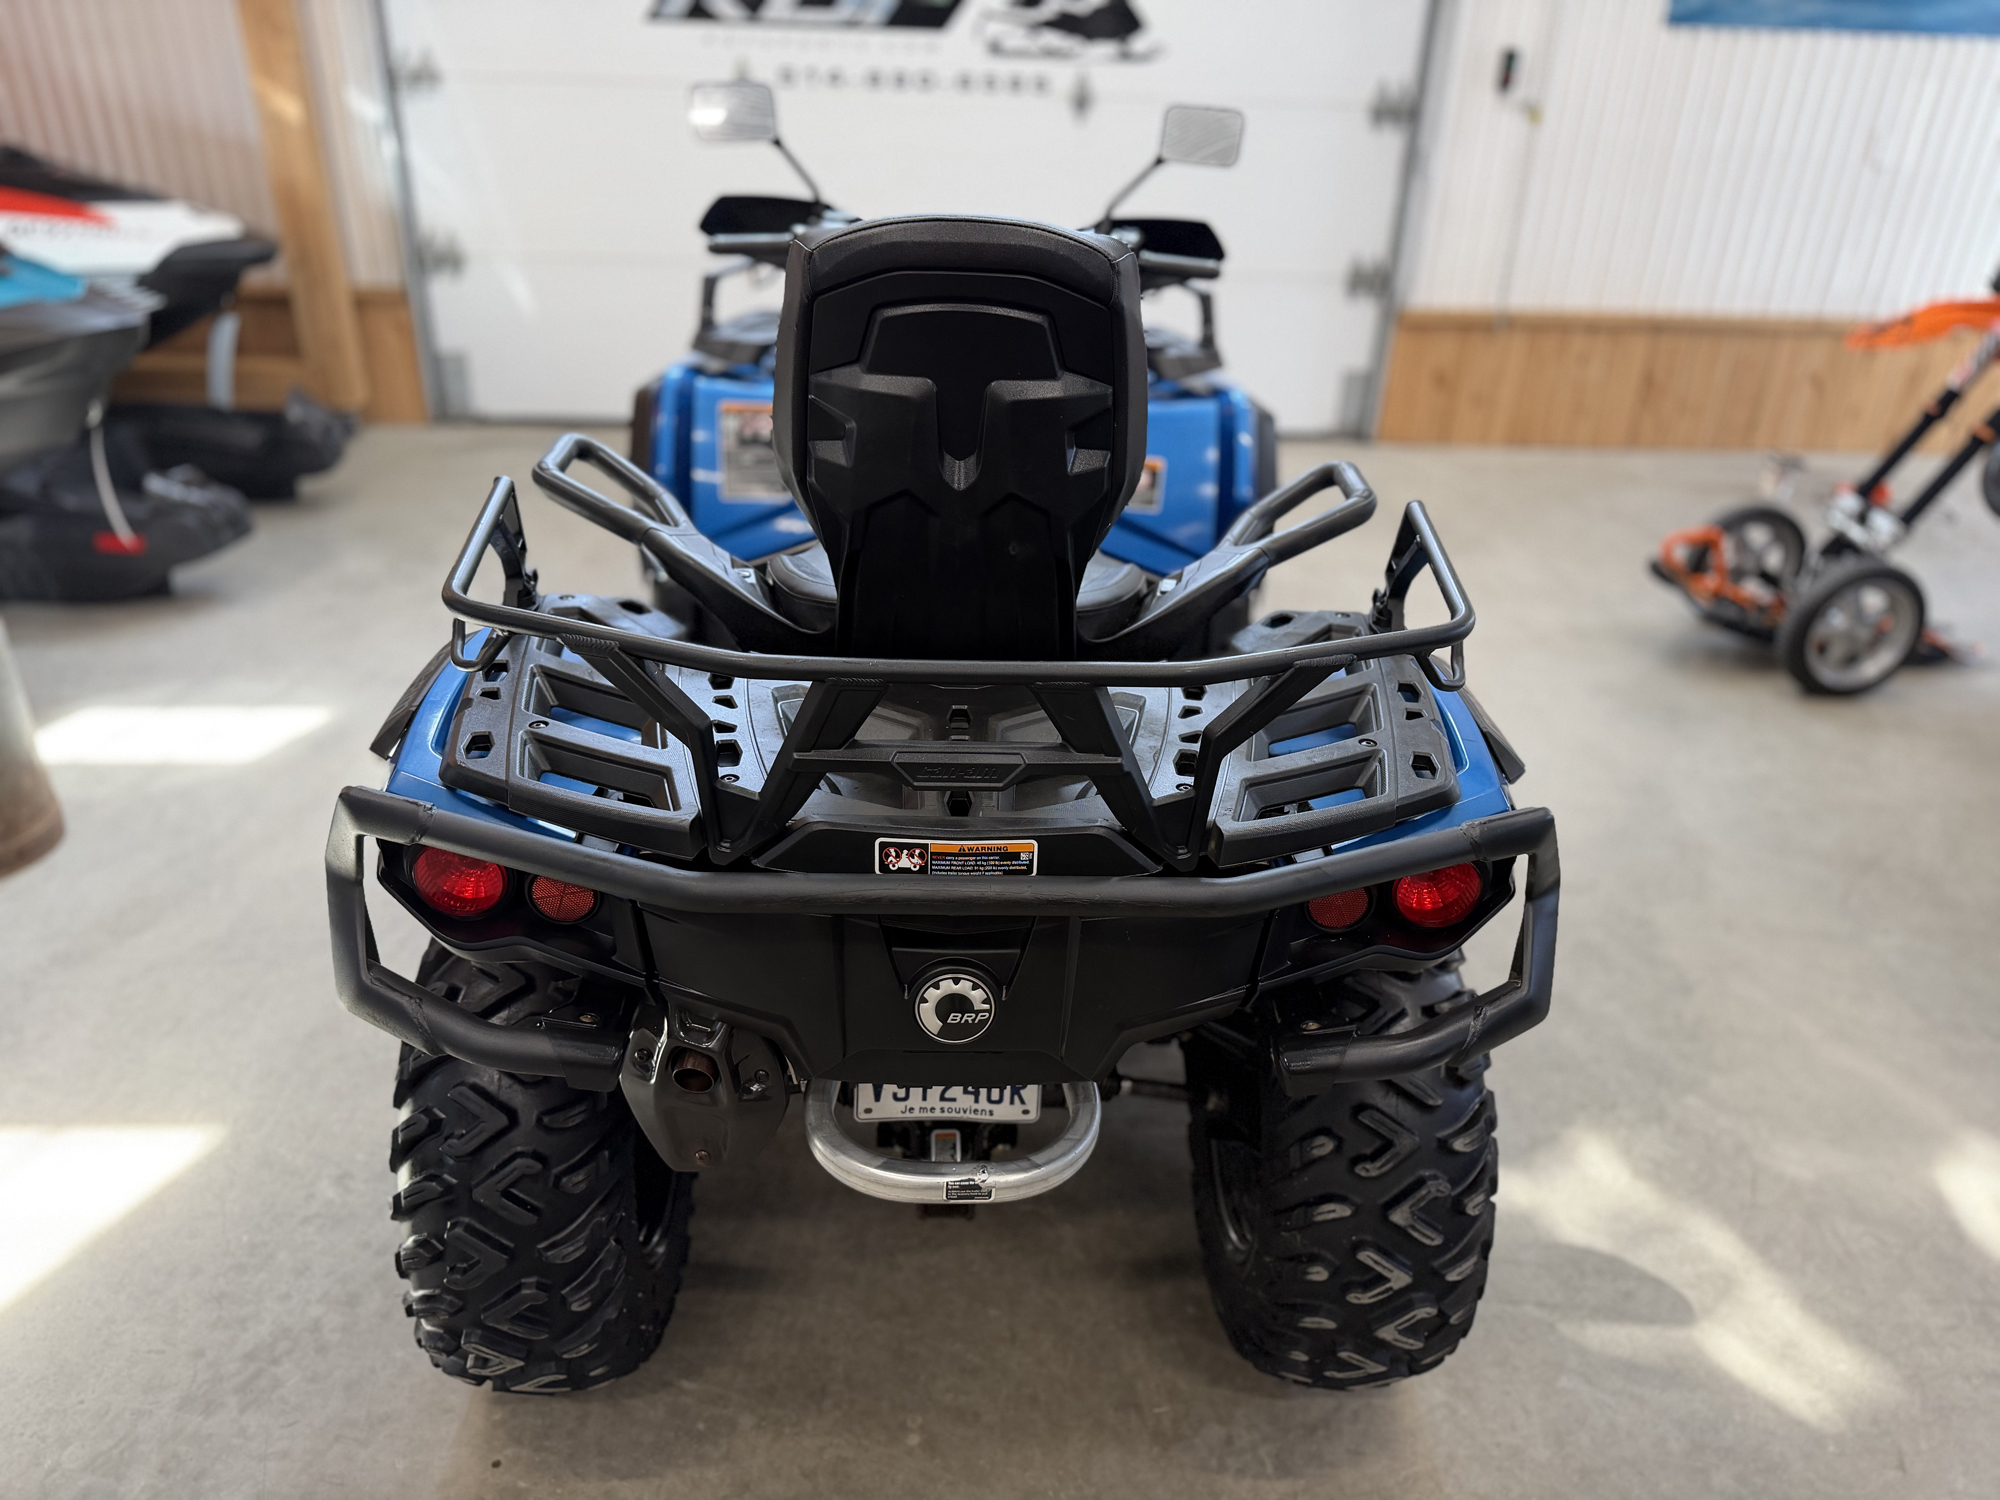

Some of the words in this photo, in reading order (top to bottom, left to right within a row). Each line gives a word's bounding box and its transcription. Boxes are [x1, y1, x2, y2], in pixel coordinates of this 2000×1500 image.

[946, 1012, 990, 1024] BRP
[901, 1105, 915, 1114] Je
[919, 1106, 936, 1114] me
[939, 1106, 995, 1116] souviens
